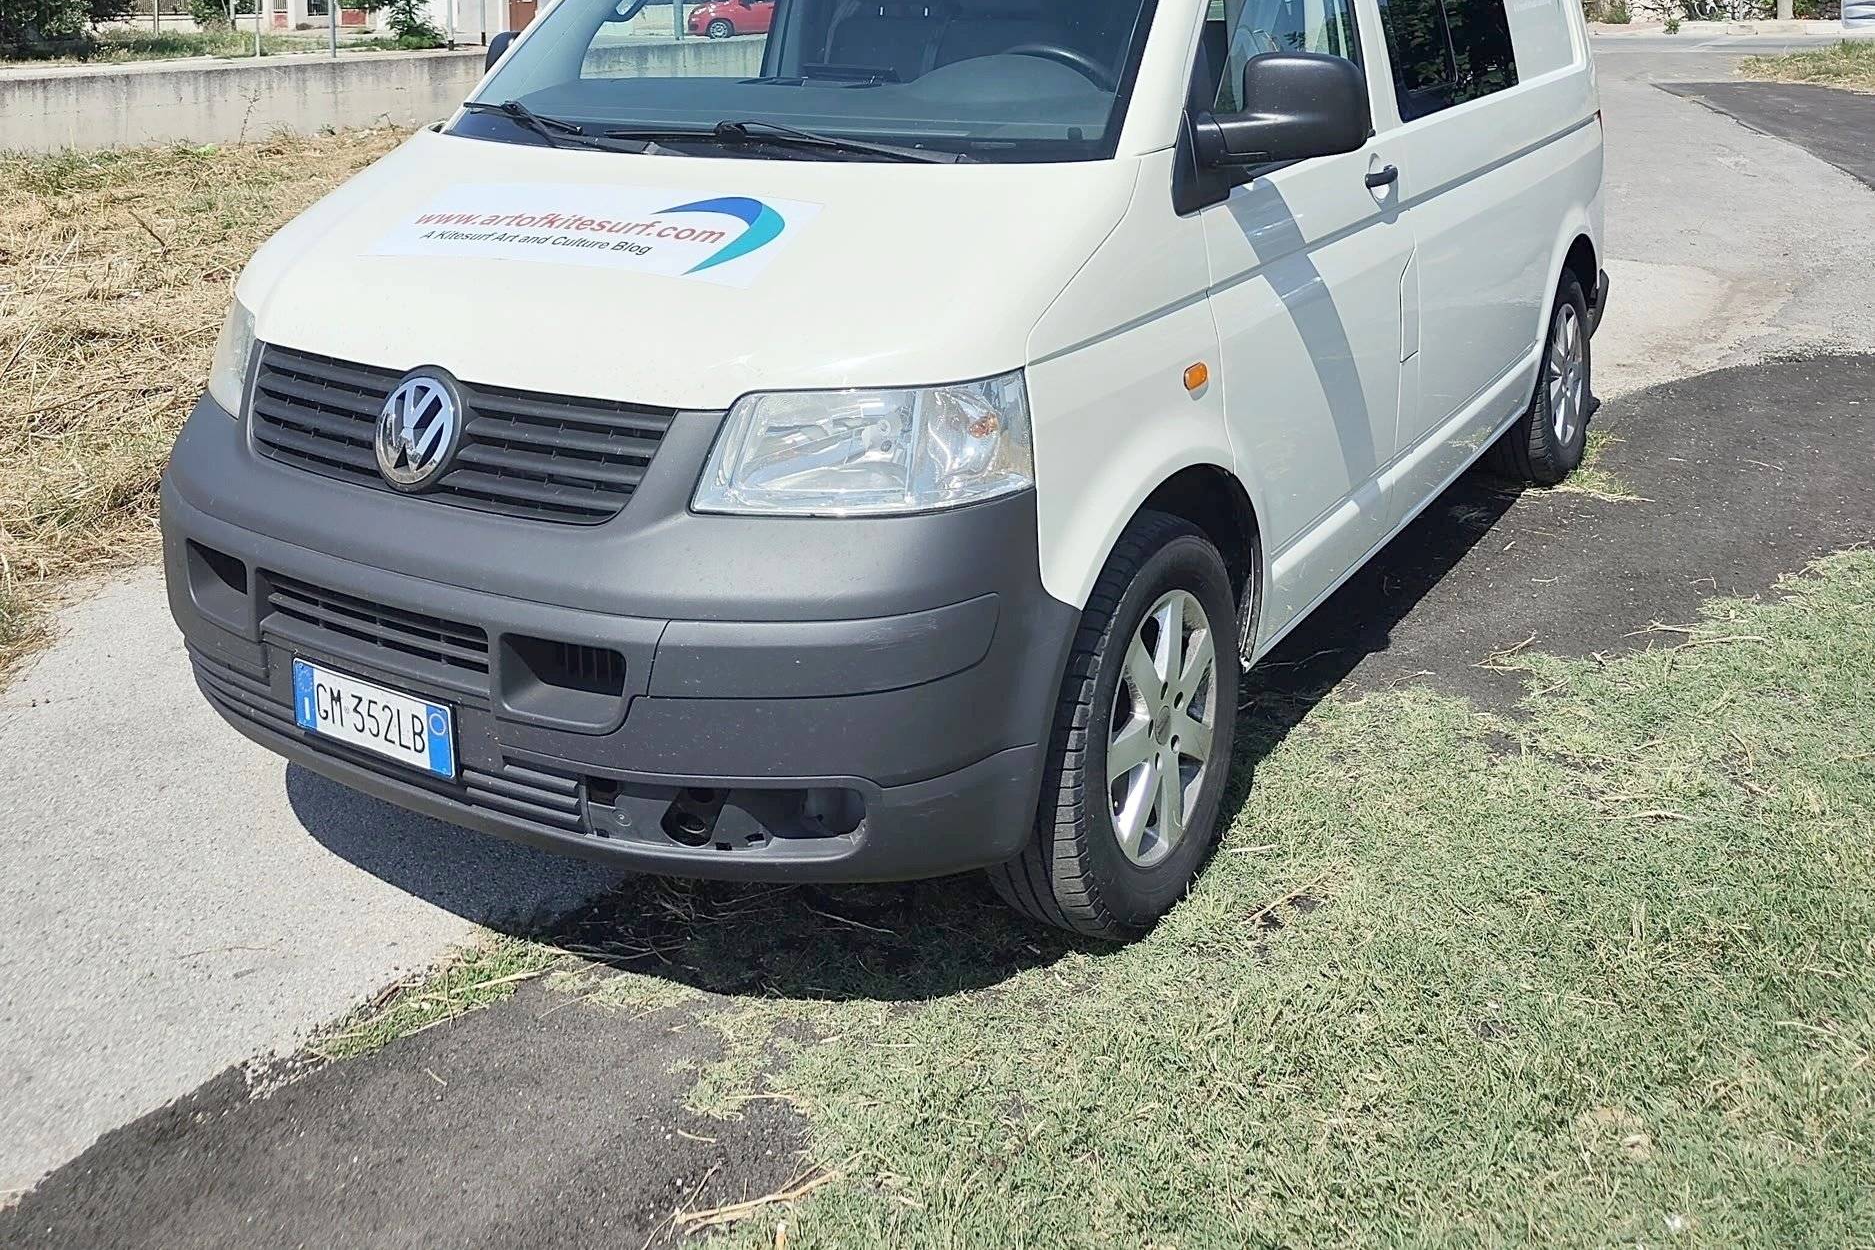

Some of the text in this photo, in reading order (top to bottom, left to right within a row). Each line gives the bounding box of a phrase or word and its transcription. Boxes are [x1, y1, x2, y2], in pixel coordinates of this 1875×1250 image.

[414, 213, 726, 244] www.artofkitesurf.com
[420, 230, 653, 256] A Kitesurf Art and Culture Blog
